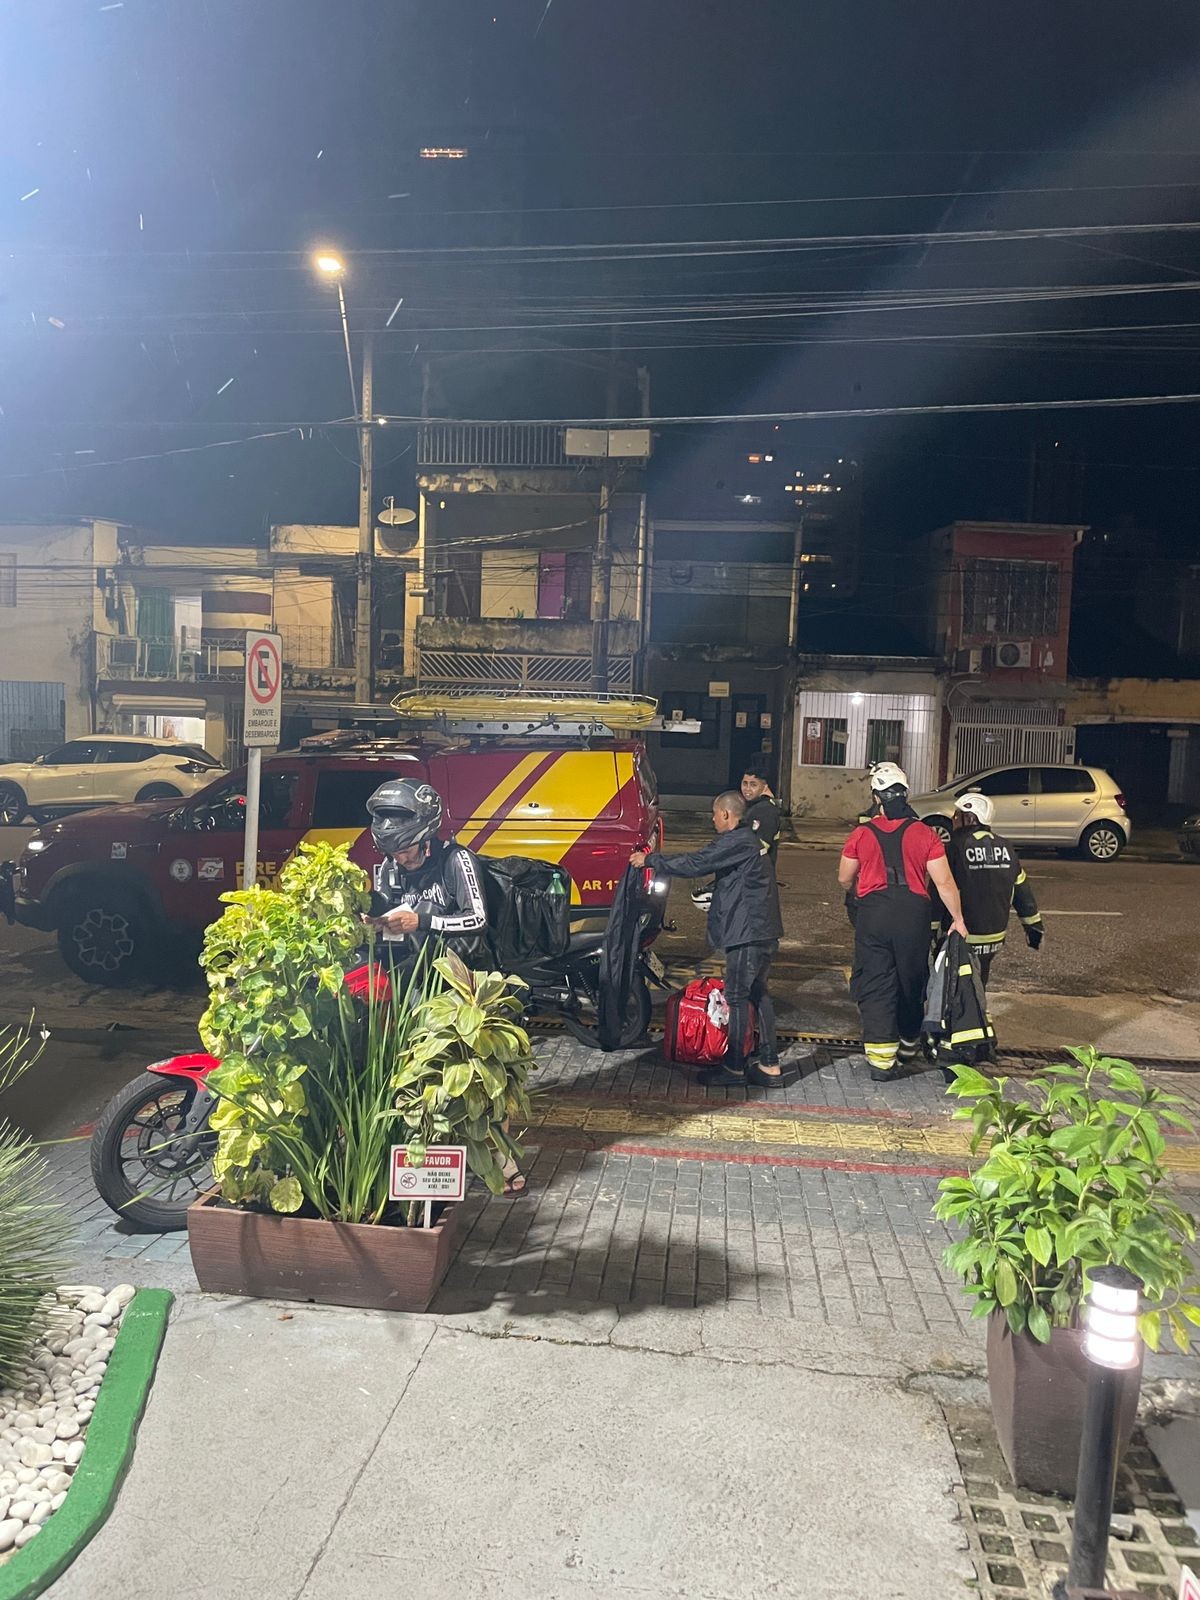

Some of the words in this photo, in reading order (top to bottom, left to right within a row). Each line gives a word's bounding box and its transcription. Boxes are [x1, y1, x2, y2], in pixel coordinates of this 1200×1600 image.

[252, 708, 274, 717] SOMENTE
[248, 719, 272, 728] EMBARQUE
[273, 719, 278, 728] E
[245, 729, 279, 739] DESEMBARQUE
[235, 861, 277, 875] FRE
[582, 879, 602, 891] AR
[425, 1156, 451, 1166] FAVOR
